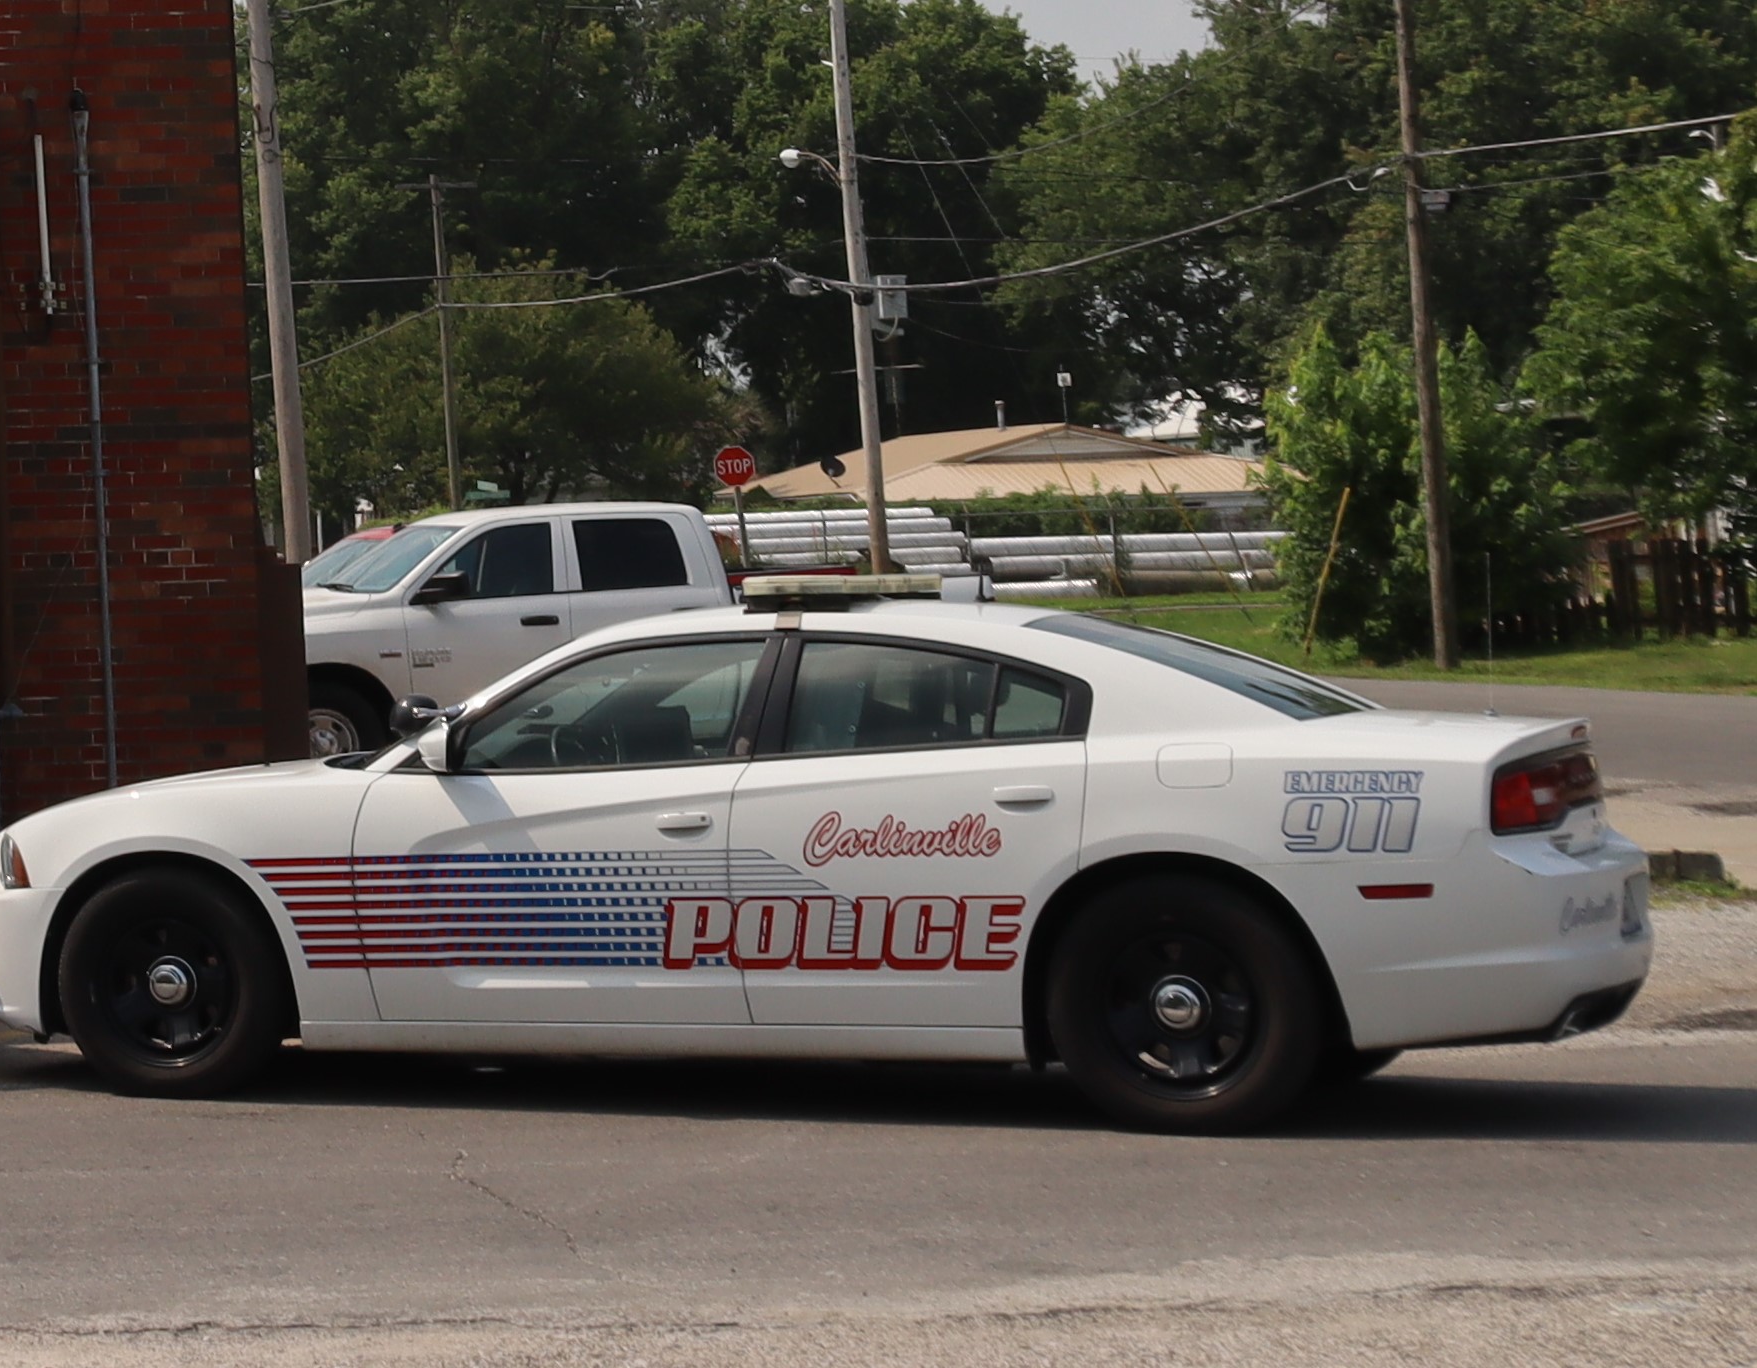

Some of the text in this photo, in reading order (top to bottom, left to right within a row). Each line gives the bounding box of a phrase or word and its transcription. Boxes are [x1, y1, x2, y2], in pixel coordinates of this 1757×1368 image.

[717, 458, 751, 475] STOP
[1284, 770, 1424, 794] EMERGENCY
[803, 811, 1001, 867] Carlinville
[1281, 796, 1421, 853] 911
[662, 895, 1026, 971] POLICE
